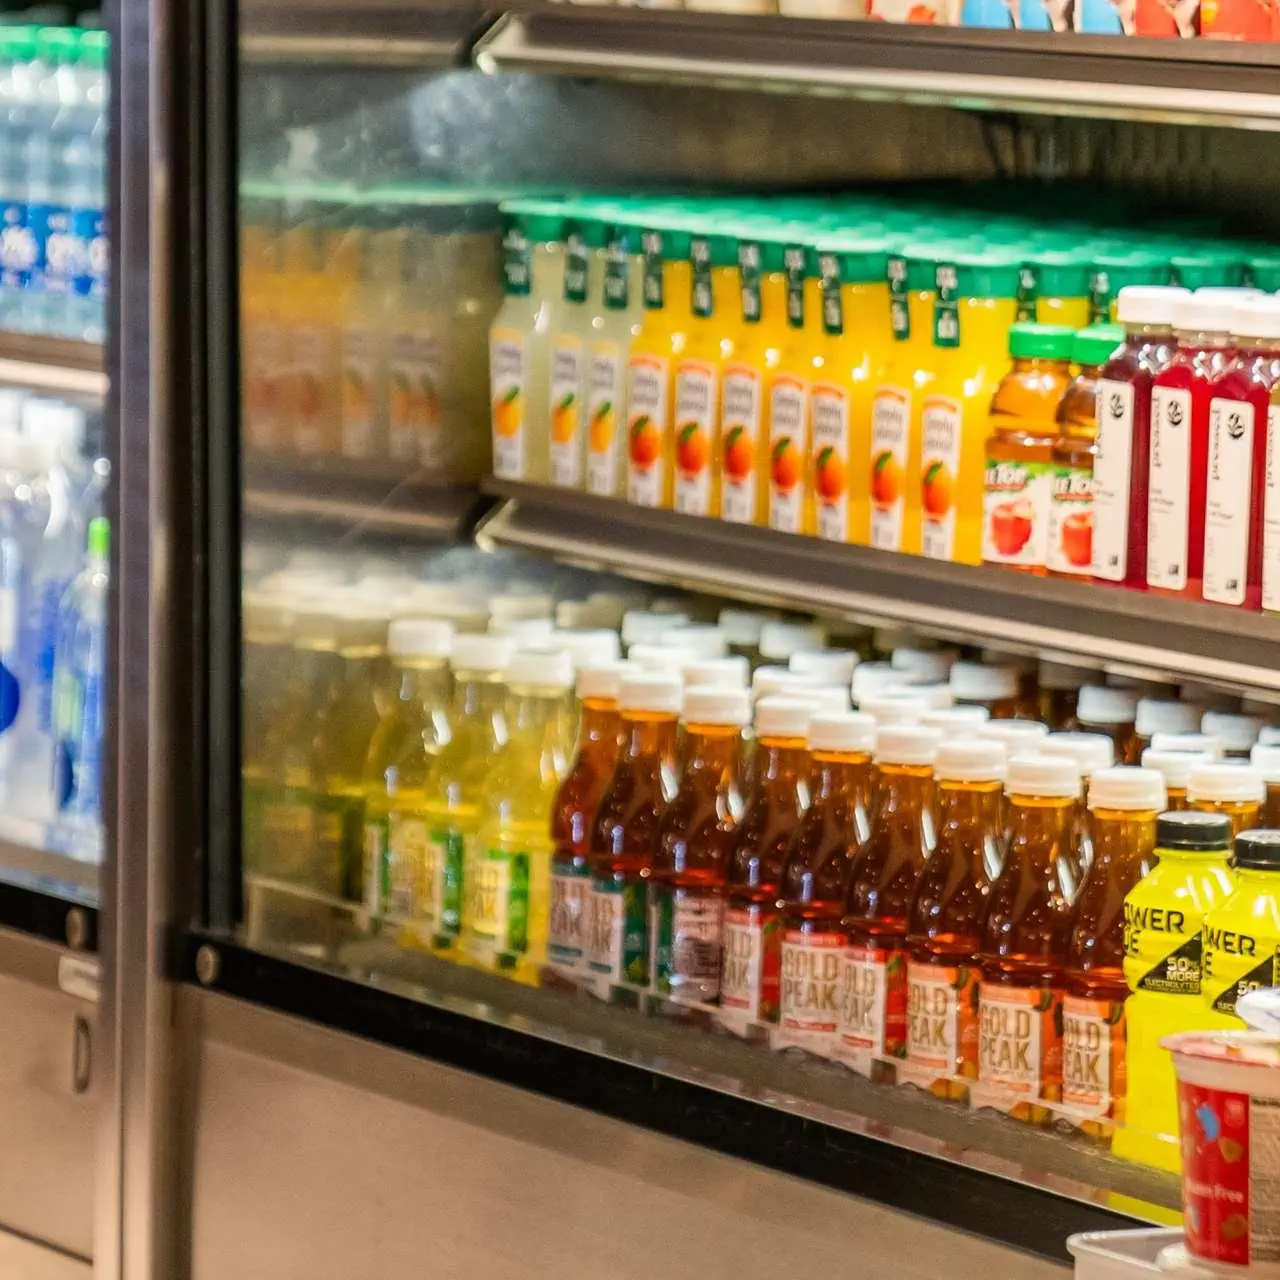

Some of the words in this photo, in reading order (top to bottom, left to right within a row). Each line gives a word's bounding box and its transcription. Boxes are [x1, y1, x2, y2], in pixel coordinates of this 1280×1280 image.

[1123, 901, 1185, 934] OWER
[1202, 923, 1256, 957] WER
[844, 963, 876, 996] OLD
[1144, 977, 1200, 991] ELECTROLYTES
[1166, 970, 1200, 983] MORE
[1237, 980, 1261, 996] 50
[783, 979, 837, 1012] PEAK
[910, 982, 948, 1017] OLD
[910, 1014, 948, 1048] EAK
[1064, 1016, 1101, 1053] OLD
[980, 1034, 1033, 1071] PEAK
[1064, 1042, 1102, 1085] EAK
